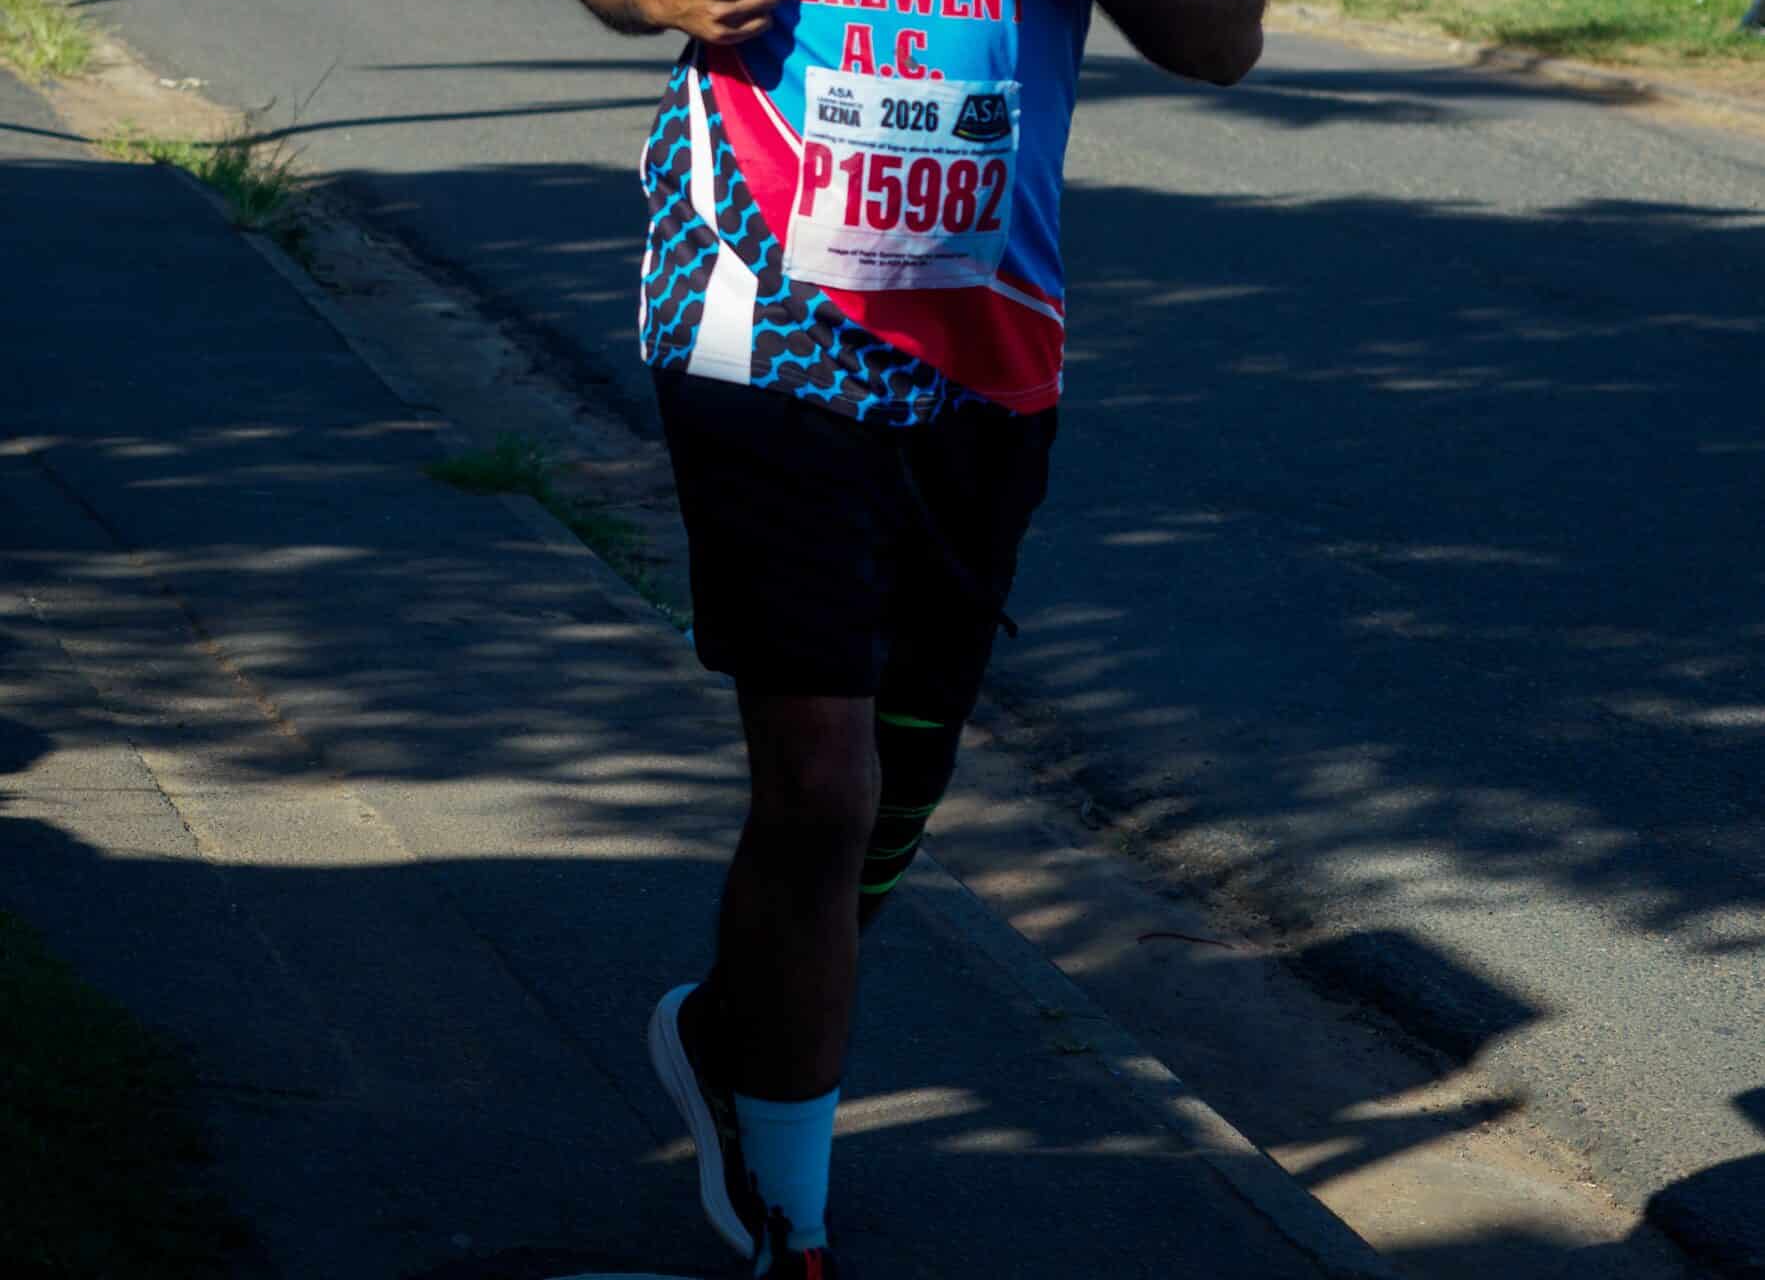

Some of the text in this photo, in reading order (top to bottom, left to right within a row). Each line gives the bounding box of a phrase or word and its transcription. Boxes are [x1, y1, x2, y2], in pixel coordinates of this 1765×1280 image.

[841, 23, 944, 80] A.C.
[827, 87, 855, 101] ASA
[818, 104, 861, 128] KZNA
[880, 97, 940, 132] 2026
[963, 99, 1005, 124] ASA
